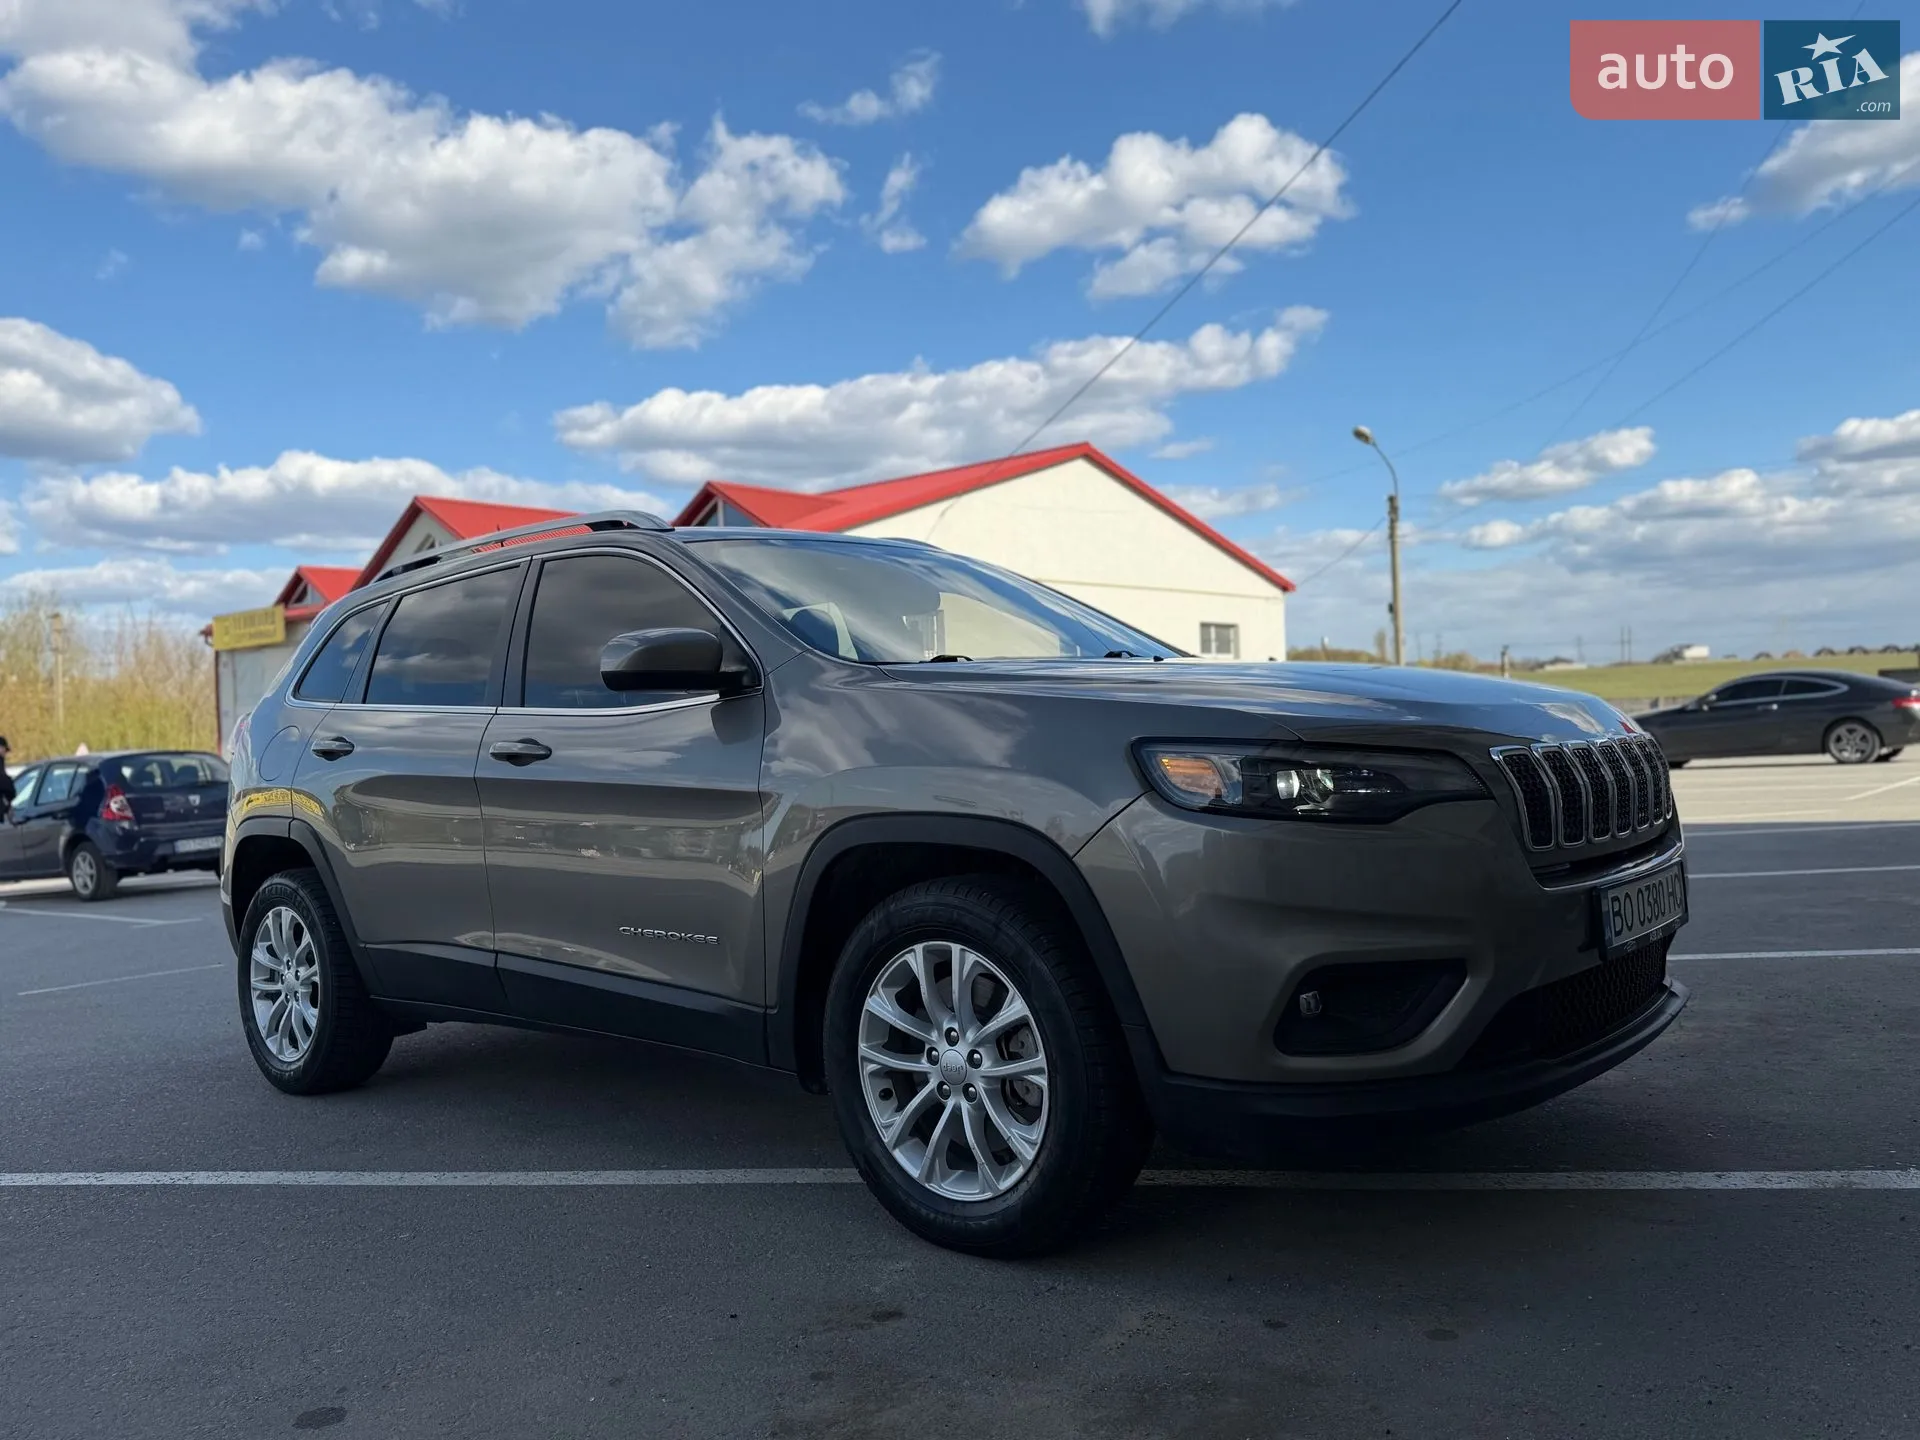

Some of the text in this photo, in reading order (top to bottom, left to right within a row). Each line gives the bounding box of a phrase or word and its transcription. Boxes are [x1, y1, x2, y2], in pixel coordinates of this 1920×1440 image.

[1611, 891, 1634, 938] BO
[1637, 880, 1666, 927] 0380
[619, 926, 720, 945] CHEROKEE
